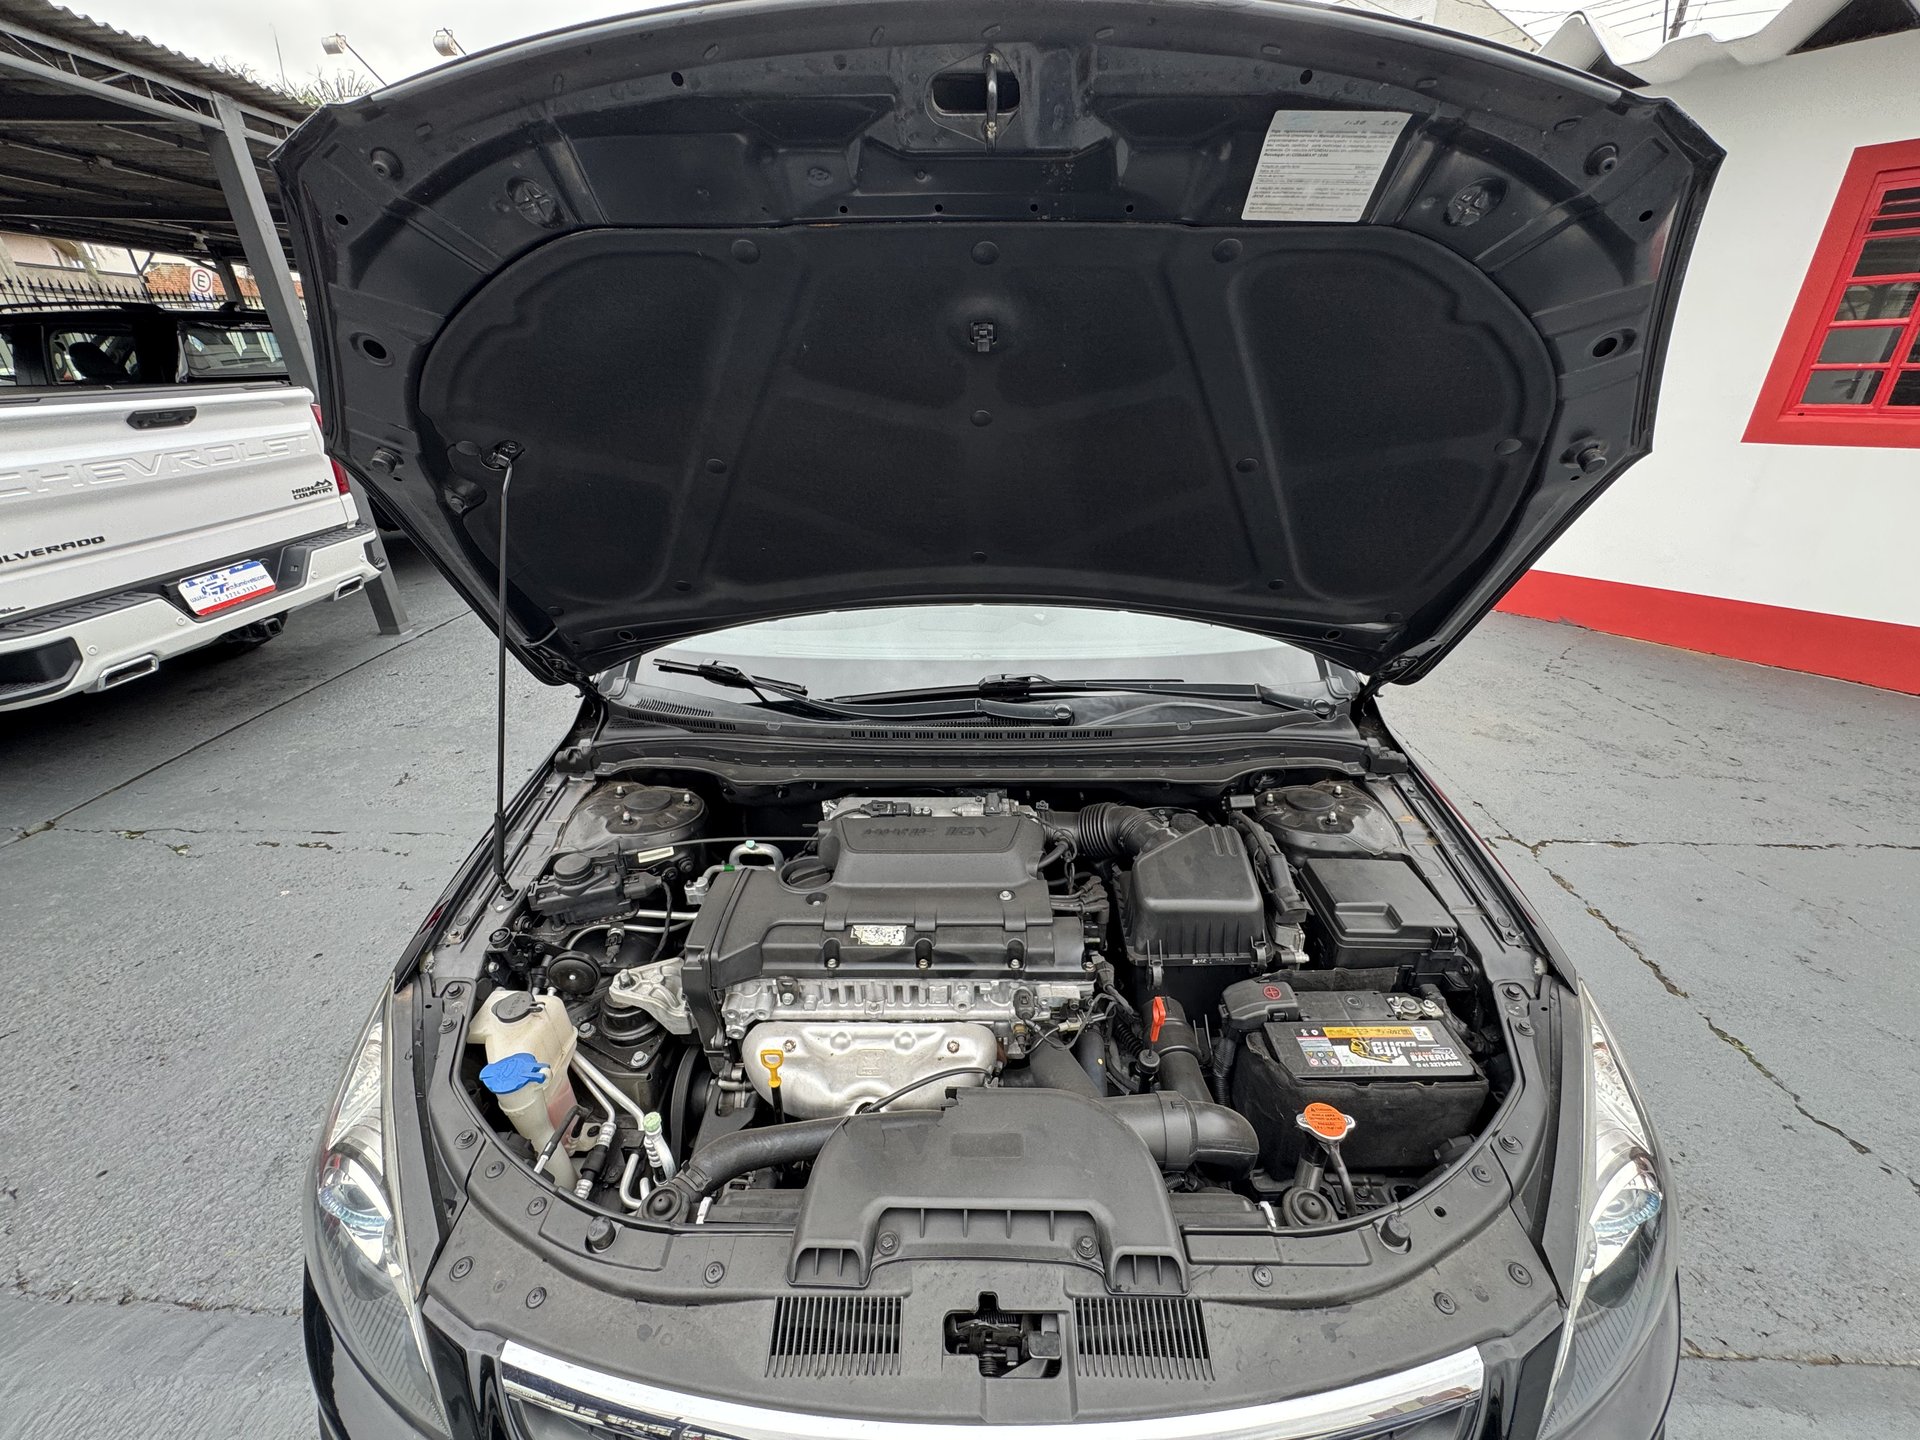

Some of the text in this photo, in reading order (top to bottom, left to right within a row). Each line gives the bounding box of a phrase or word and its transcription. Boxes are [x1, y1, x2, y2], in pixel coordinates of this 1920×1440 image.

[197, 273, 206, 288] E
[291, 485, 315, 494] HIGH
[293, 486, 333, 500] COUNTRY
[1410, 1053, 1459, 1061] BATERIAS
